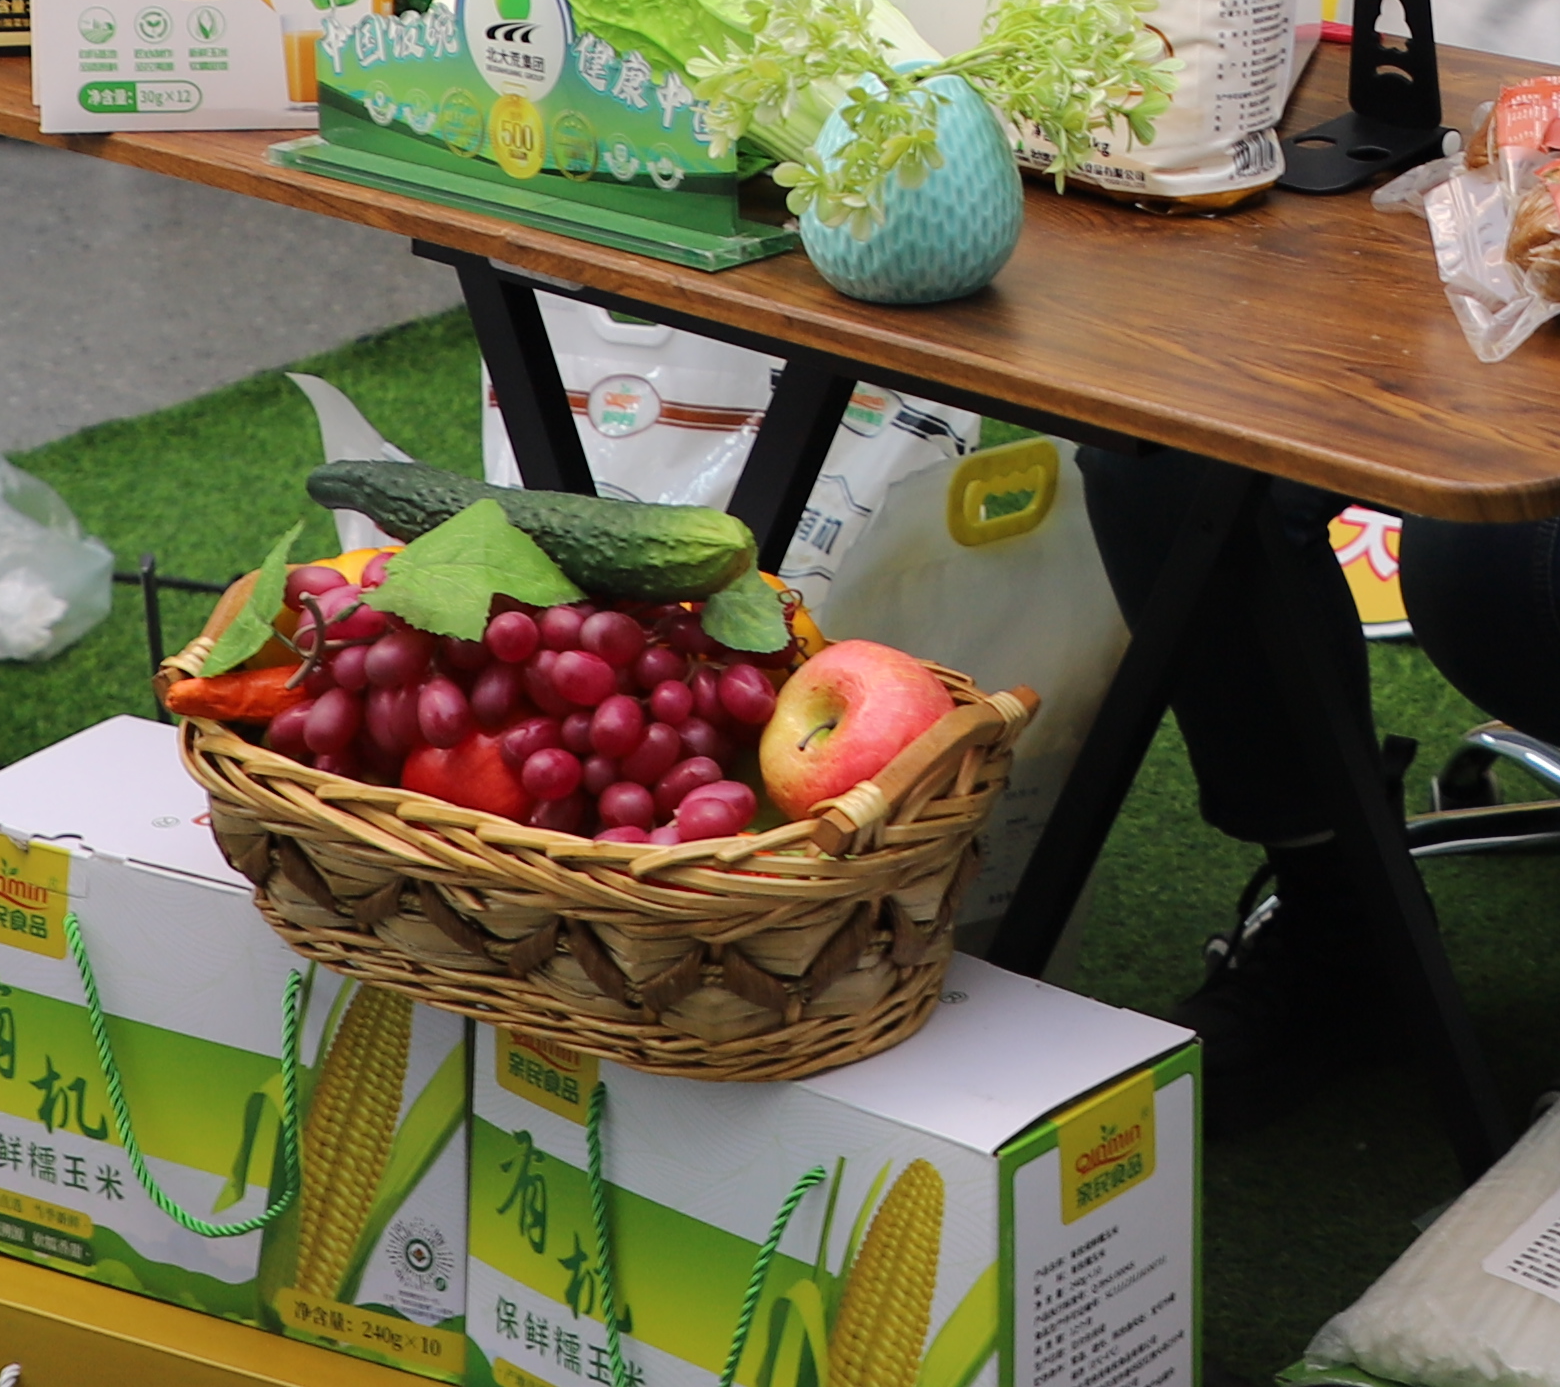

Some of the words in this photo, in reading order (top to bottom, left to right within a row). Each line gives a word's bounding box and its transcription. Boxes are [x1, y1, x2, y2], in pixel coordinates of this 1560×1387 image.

[320, 7, 460, 75] 中国饭碗
[485, 47, 546, 74] 北大荒集团
[500, 120, 535, 152] 500
[507, 1051, 581, 1105] 亲民食品
[496, 1129, 634, 1335] 有机
